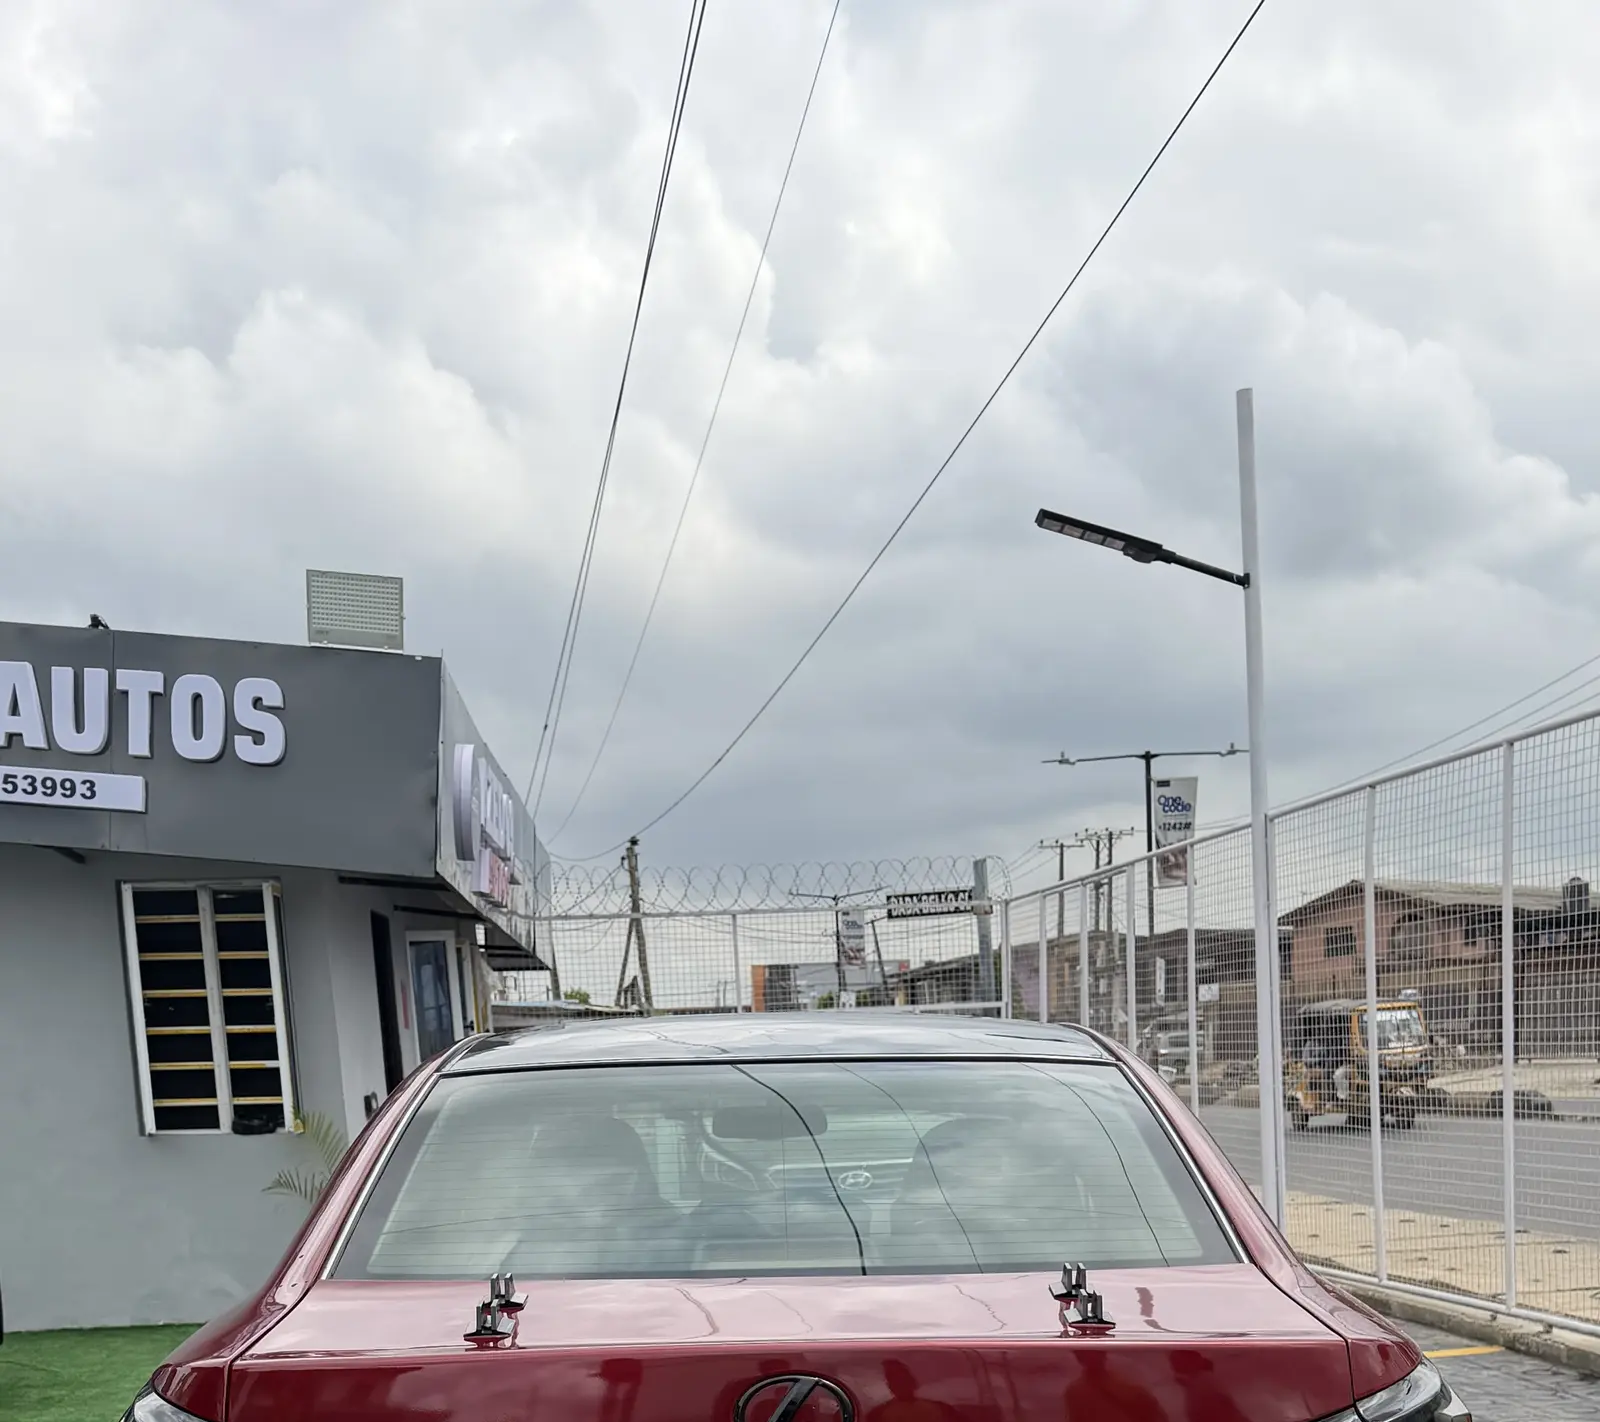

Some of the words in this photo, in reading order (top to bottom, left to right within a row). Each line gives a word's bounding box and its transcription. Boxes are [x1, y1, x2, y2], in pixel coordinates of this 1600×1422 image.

[0, 661, 287, 765] AUTOS
[1, 773, 97, 800] 53993
[1157, 795, 1182, 806] One
[1162, 801, 1192, 813] code
